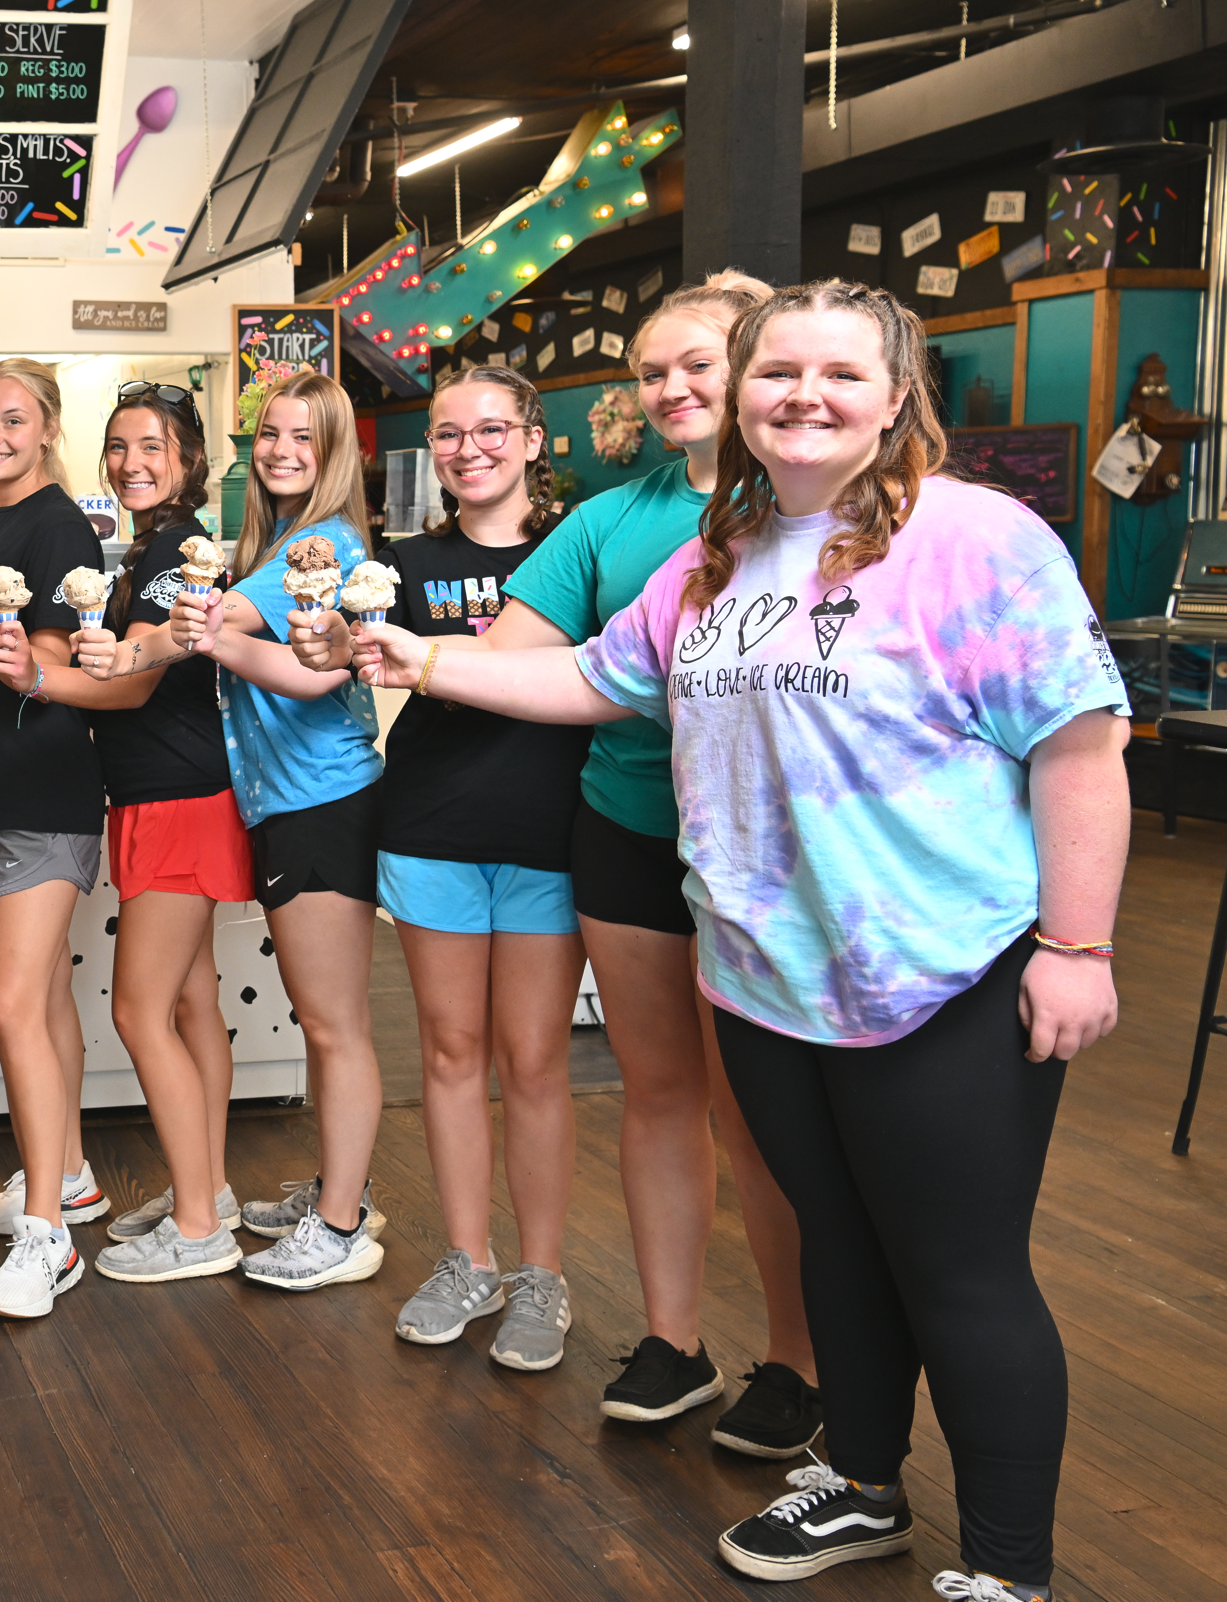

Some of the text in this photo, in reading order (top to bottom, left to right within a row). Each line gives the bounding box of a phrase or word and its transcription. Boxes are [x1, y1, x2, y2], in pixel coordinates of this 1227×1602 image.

[4, 22, 68, 54] SERVE
[48, 60, 87, 78] $3.00
[48, 82, 88, 100] $5.00
[74, 303, 95, 322] All
[94, 309, 115, 326] you
[117, 303, 136, 320] need
[254, 332, 317, 360] START
[77, 499, 113, 510] CKER
[423, 574, 512, 620] WH
[669, 661, 849, 704] PEACE LOVE ICE CREAM
